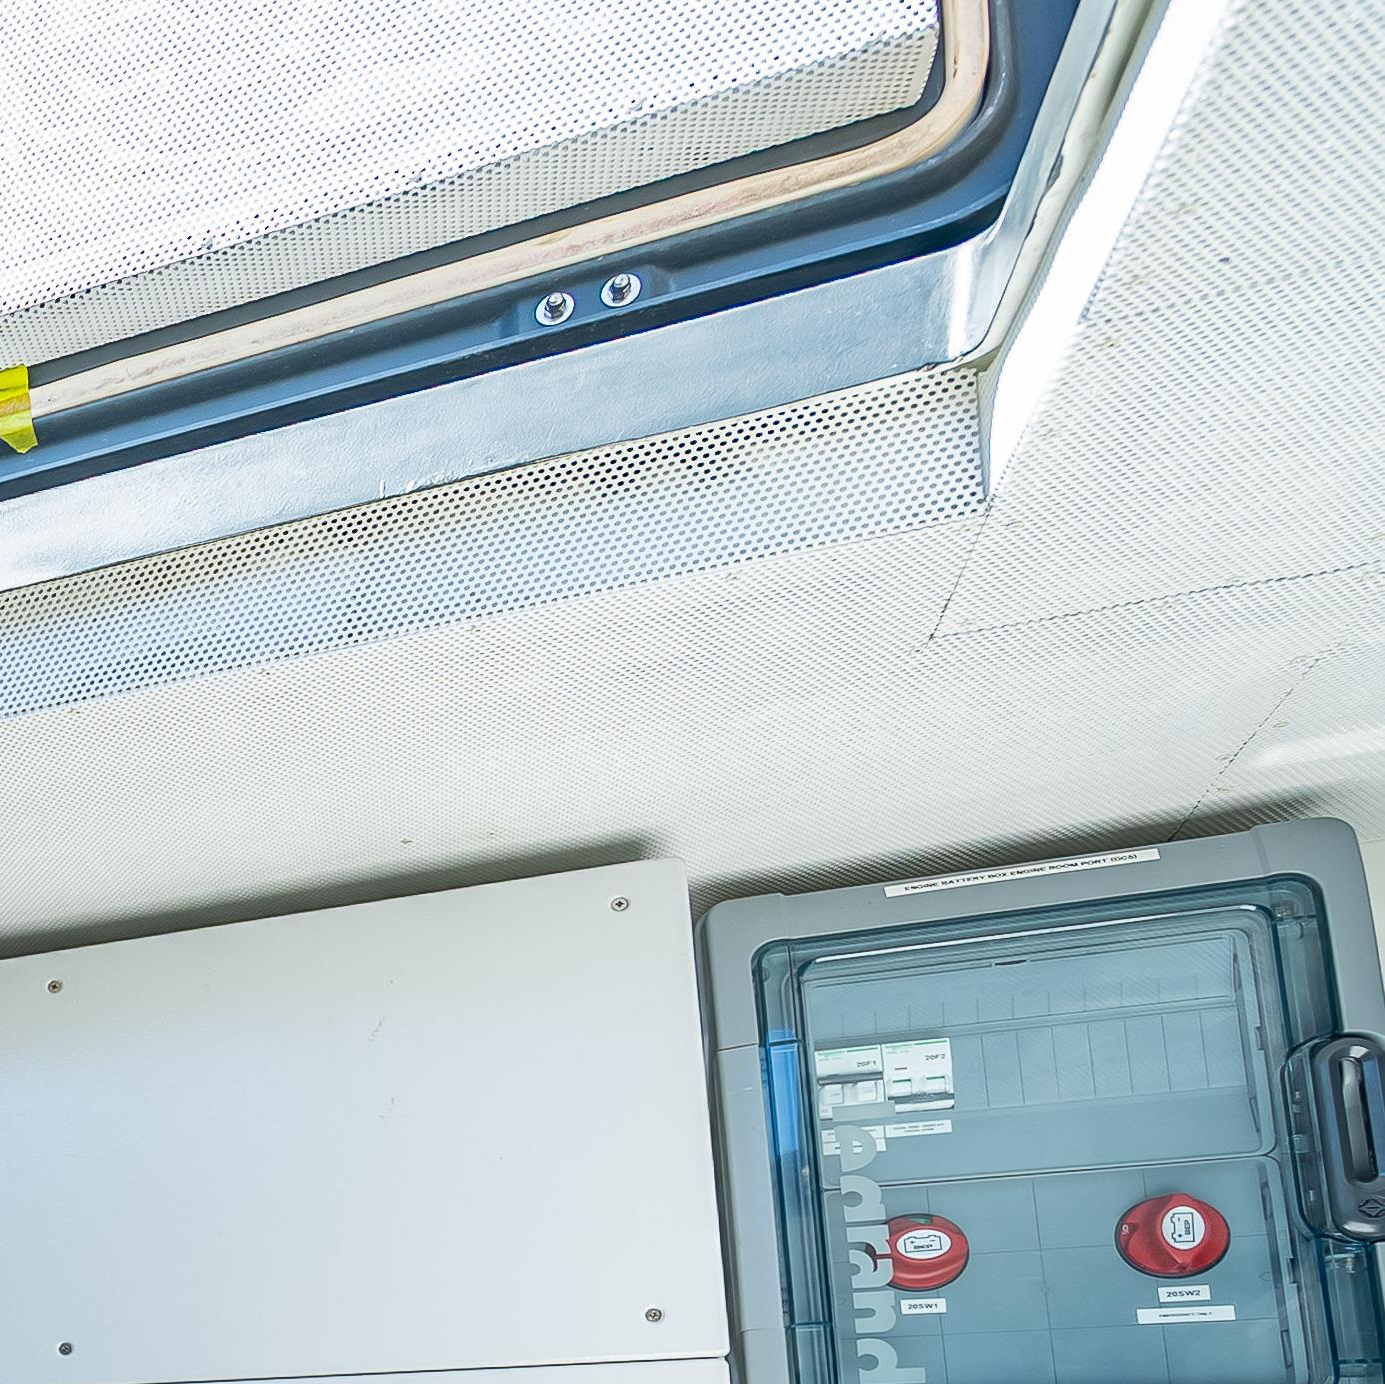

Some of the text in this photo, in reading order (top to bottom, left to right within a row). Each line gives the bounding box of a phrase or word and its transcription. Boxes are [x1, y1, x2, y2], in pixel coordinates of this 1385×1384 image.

[940, 874, 986, 887] BATTERY
[987, 871, 1008, 879] BOX
[1048, 861, 1079, 871] ROOM
[1080, 857, 1107, 867] PORT
[1166, 1289, 1201, 1298] 20SW2
